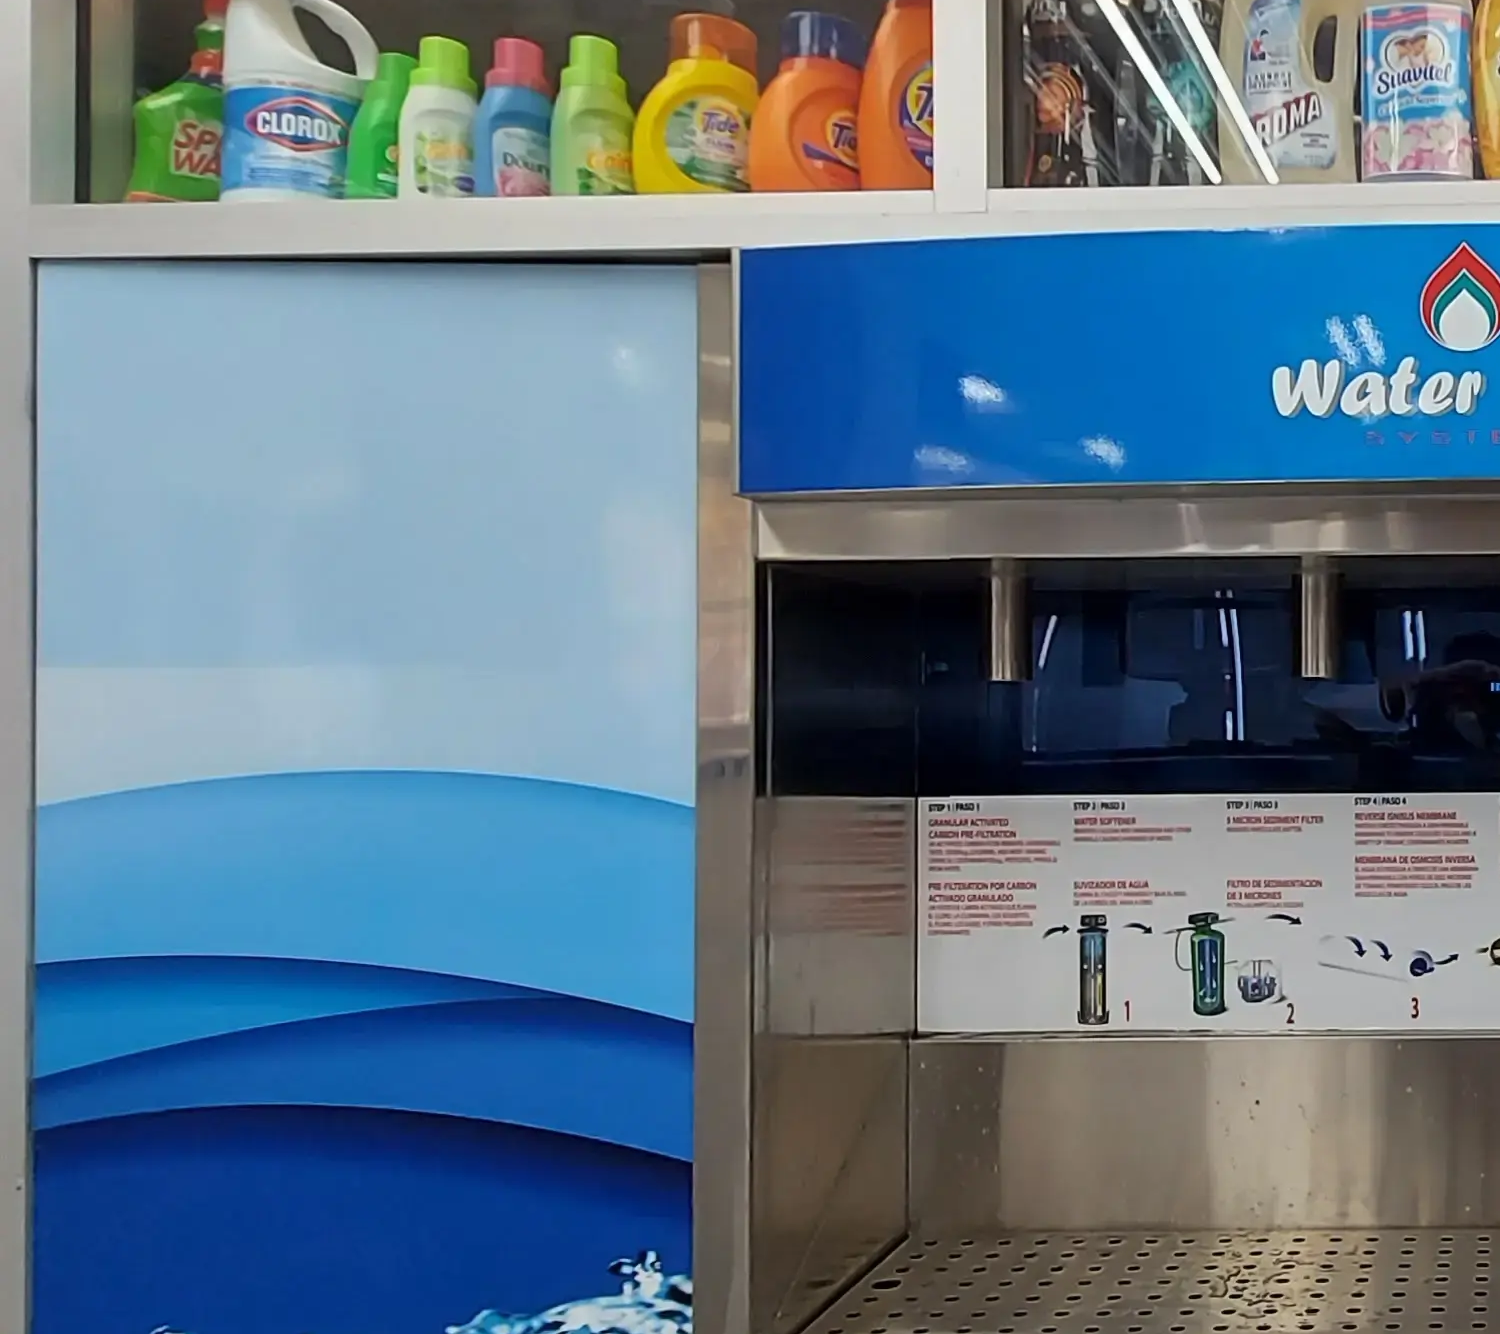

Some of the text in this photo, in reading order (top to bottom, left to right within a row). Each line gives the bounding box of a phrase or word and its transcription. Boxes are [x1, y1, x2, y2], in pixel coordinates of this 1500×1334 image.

[1377, 63, 1452, 94] Suavitel
[257, 111, 341, 145] CLOROX
[702, 111, 740, 135] Tide
[1256, 93, 1322, 147] ROMA
[1271, 357, 1485, 418] Water
[928, 803, 945, 812] STEP
[956, 803, 975, 812] PASO
[1073, 802, 1090, 810] STEP
[1101, 802, 1120, 810] PASO
[1226, 801, 1243, 809] STEP
[1254, 801, 1272, 809] PASO
[1354, 797, 1371, 805] STEP
[1382, 797, 1400, 805] PASO
[1124, 1000, 1131, 1023] 1
[1286, 1002, 1295, 1024] 2
[1410, 996, 1420, 1019] 3
